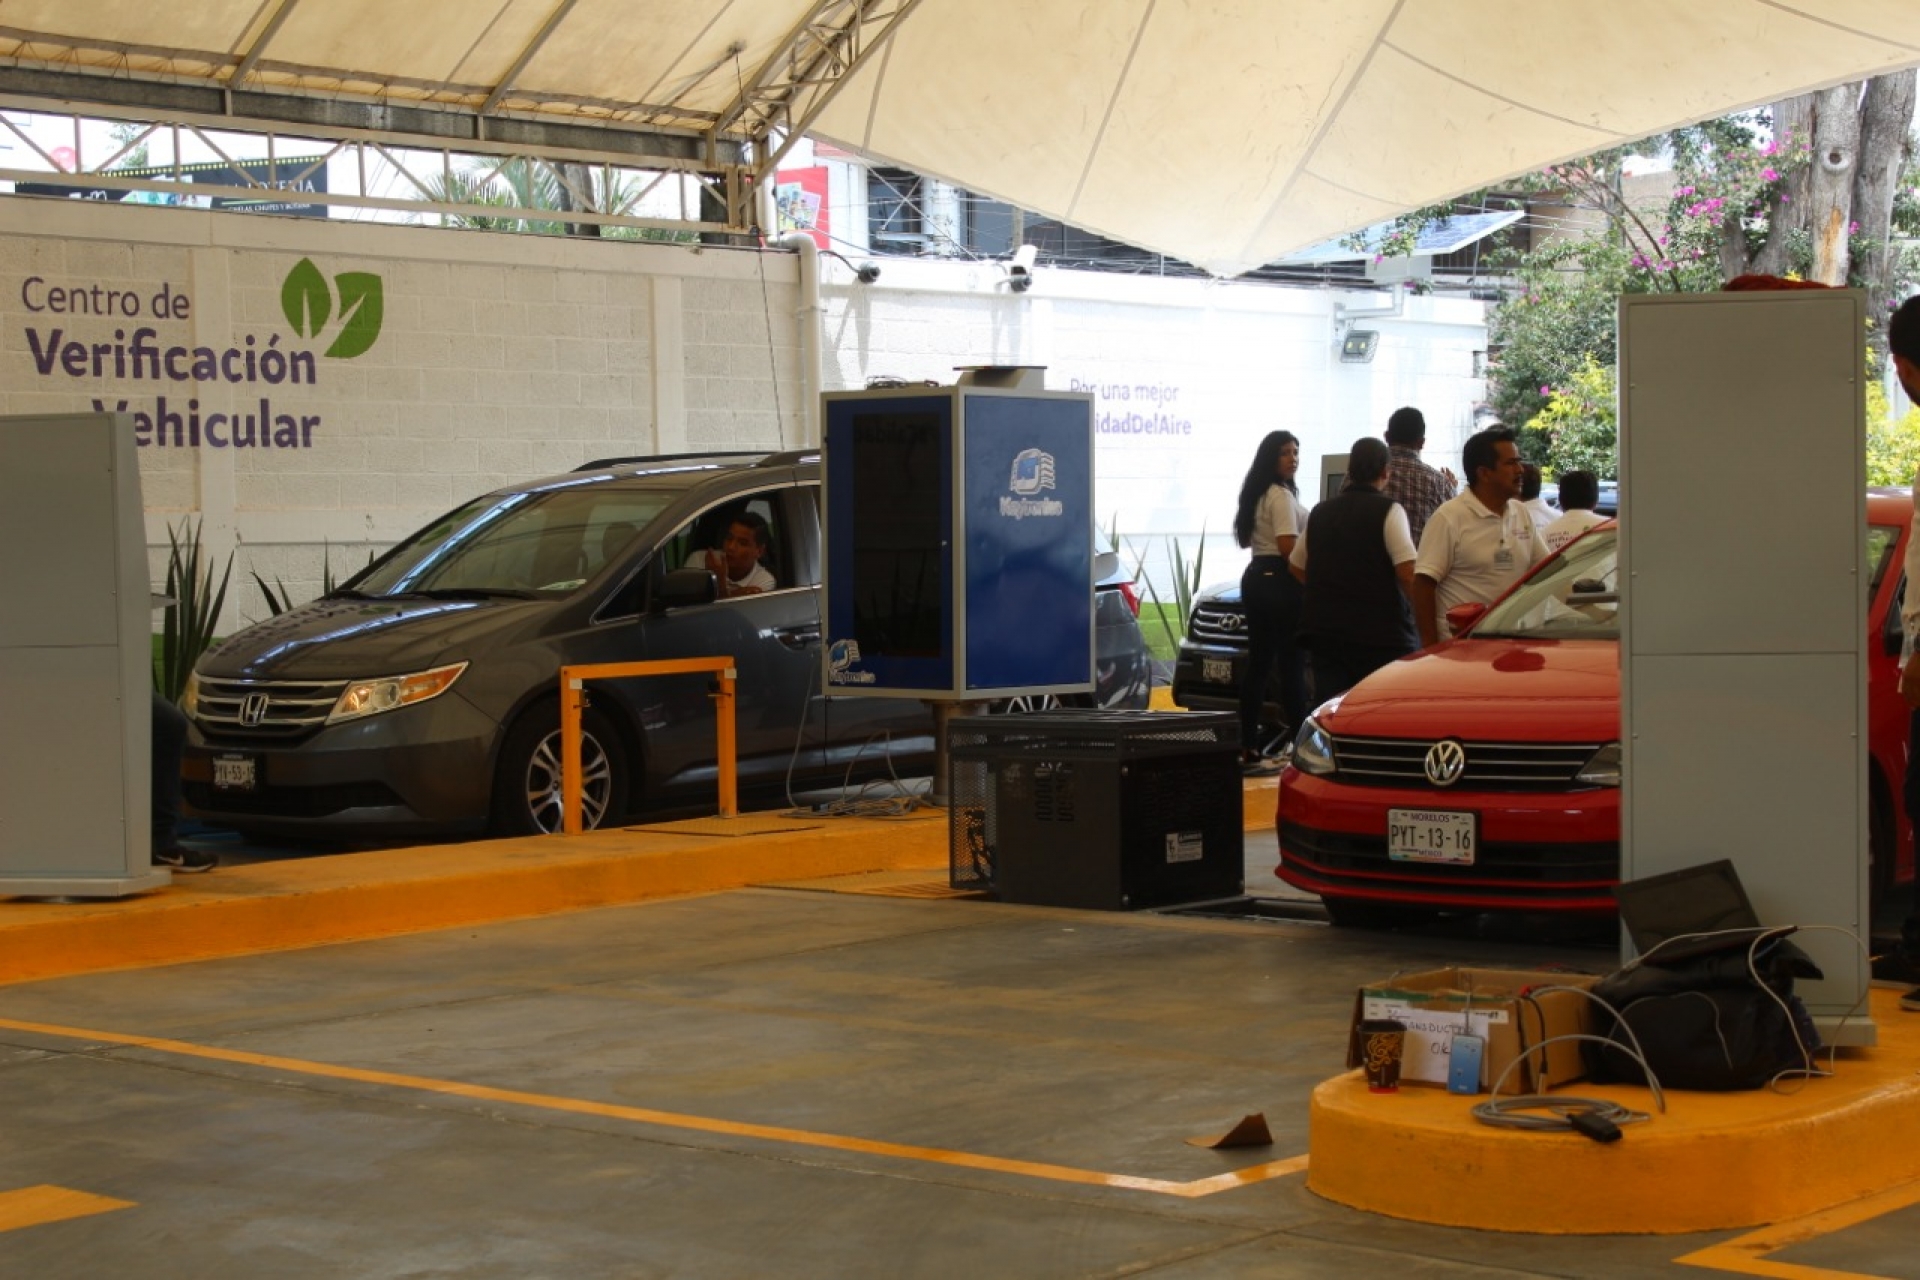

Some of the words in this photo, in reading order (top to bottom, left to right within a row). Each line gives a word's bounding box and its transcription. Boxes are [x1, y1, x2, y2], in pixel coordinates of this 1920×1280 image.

[22, 276, 140, 317] Centro
[151, 282, 190, 319] de
[25, 327, 316, 385] Verificación
[1102, 384, 1130, 401] una
[1135, 381, 1179, 408] mejor
[1095, 411, 1192, 435] idadDelAire
[1411, 812, 1450, 823] MORELOS
[1390, 825, 1471, 850] PYT-13-16
